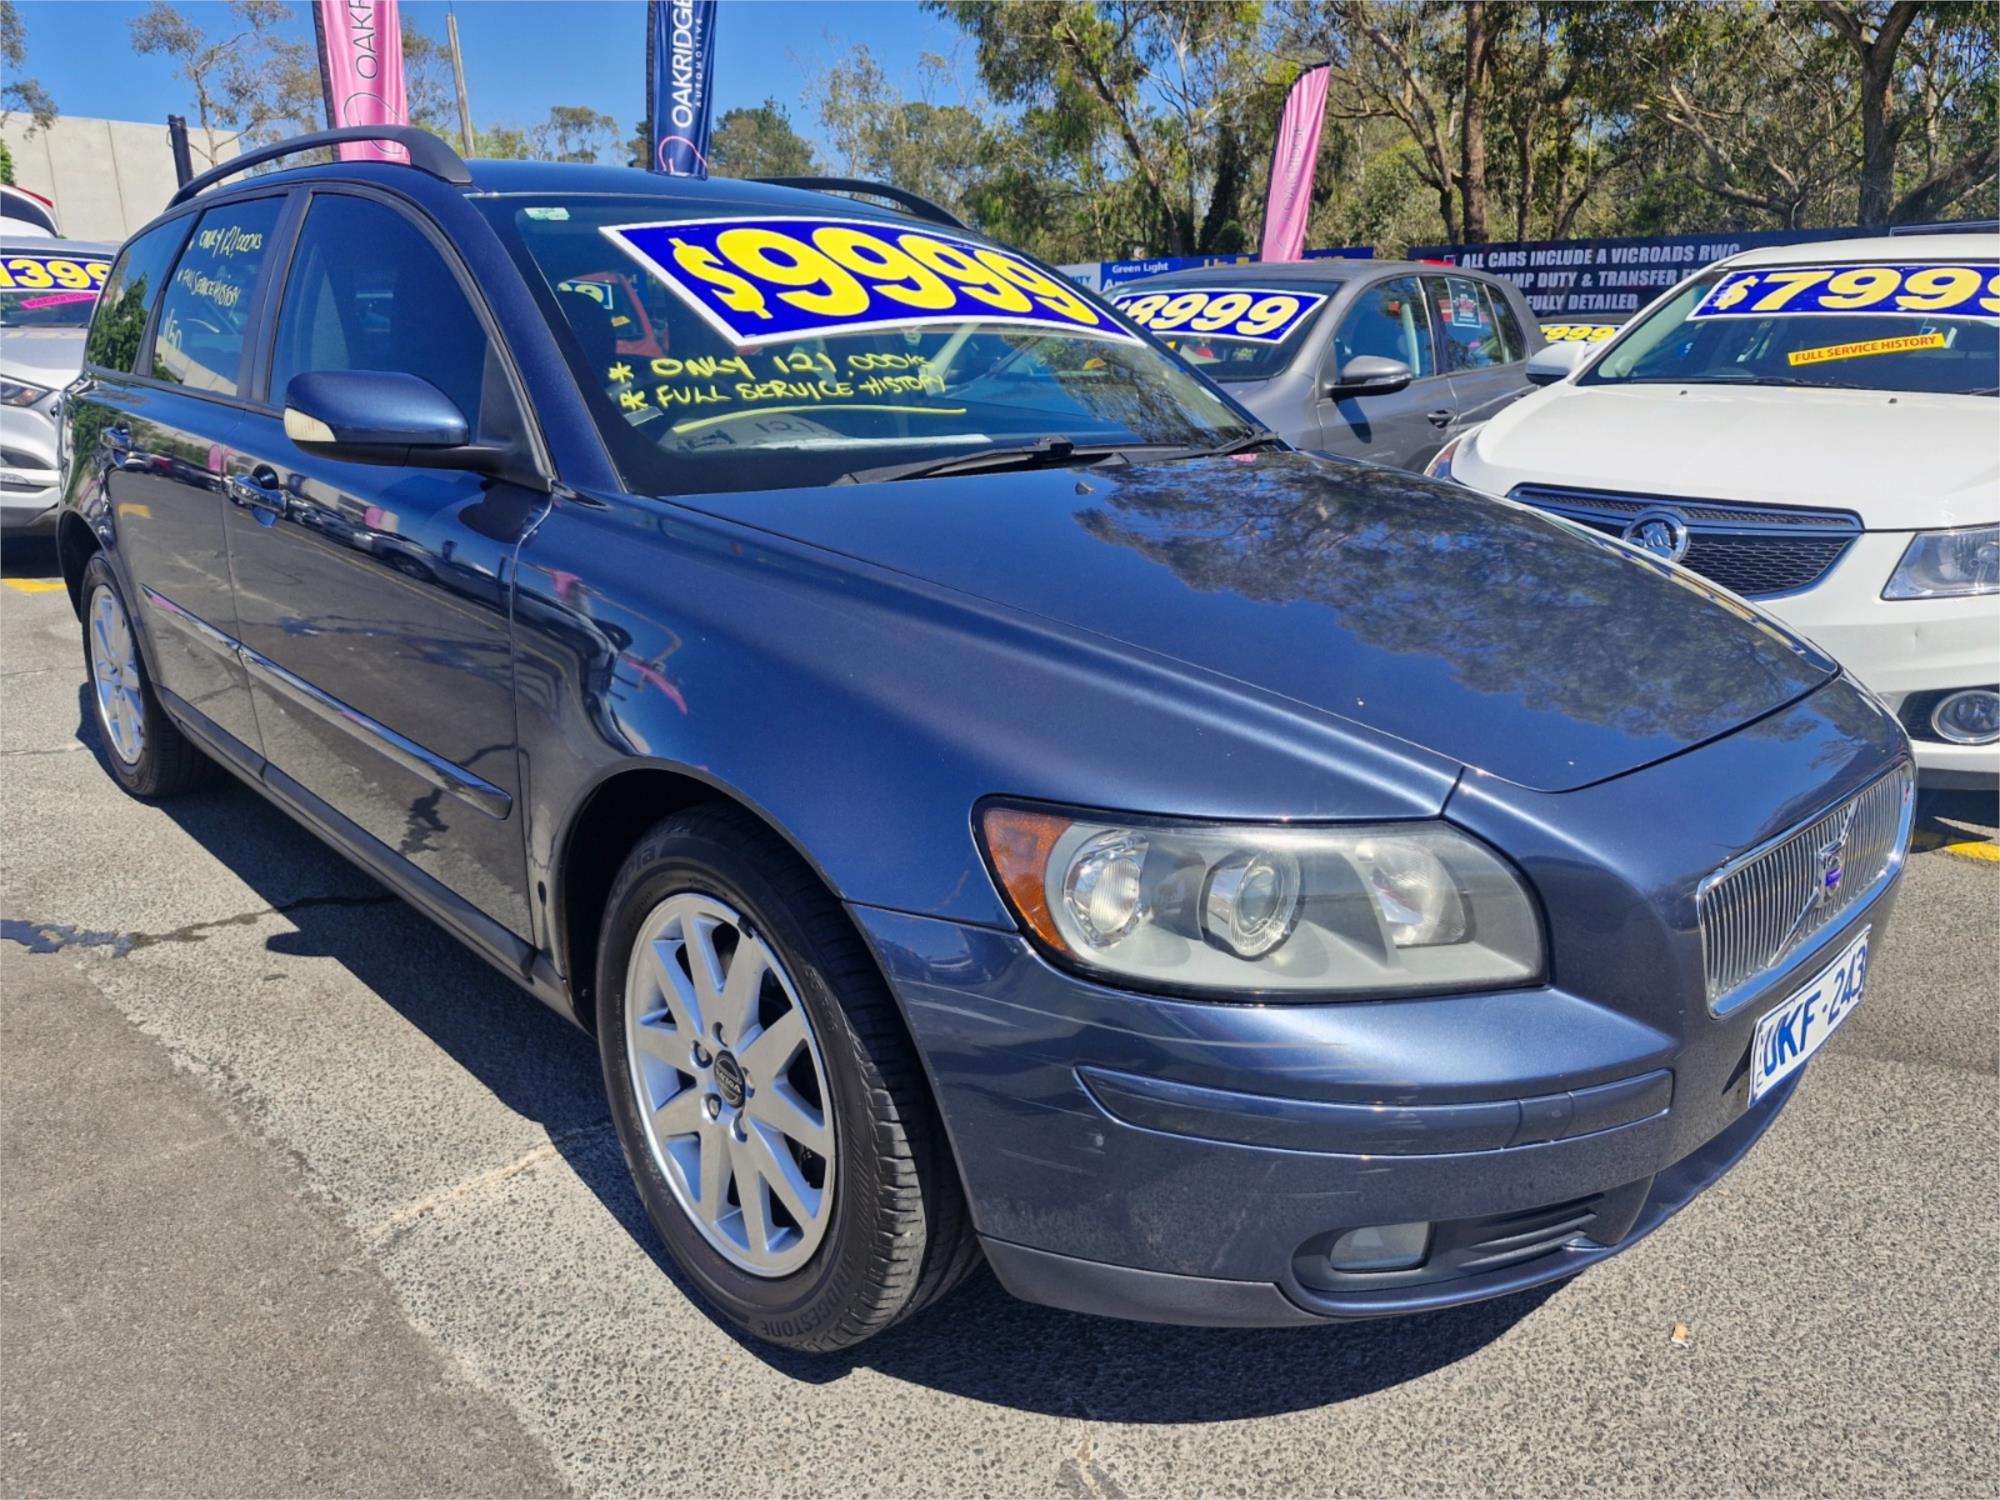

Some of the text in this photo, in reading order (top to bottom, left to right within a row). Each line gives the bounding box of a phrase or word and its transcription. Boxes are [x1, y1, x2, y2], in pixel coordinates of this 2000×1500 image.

[695, 18, 703, 108] AUTOMOTIVE
[1112, 261, 1169, 275] Green Light
[1462, 253, 1484, 268] ALL
[1488, 251, 1527, 268] CARS
[1530, 249, 1593, 266] INCLUDE
[1596, 249, 1607, 265] A
[1611, 246, 1694, 264] VICROADS
[668, 226, 1100, 326] $9999
[1537, 272, 1578, 288] DUTY
[1582, 273, 1593, 287] &
[1599, 269, 1677, 287] TRANSFER
[1526, 294, 1638, 311] FULLY DETAILED
[1715, 268, 2000, 313] $799
[1794, 336, 1937, 363] FULL SERVICE HISTORY
[651, 356, 756, 380] ONLY
[656, 375, 945, 408] FULL SERVICE HISTORY
